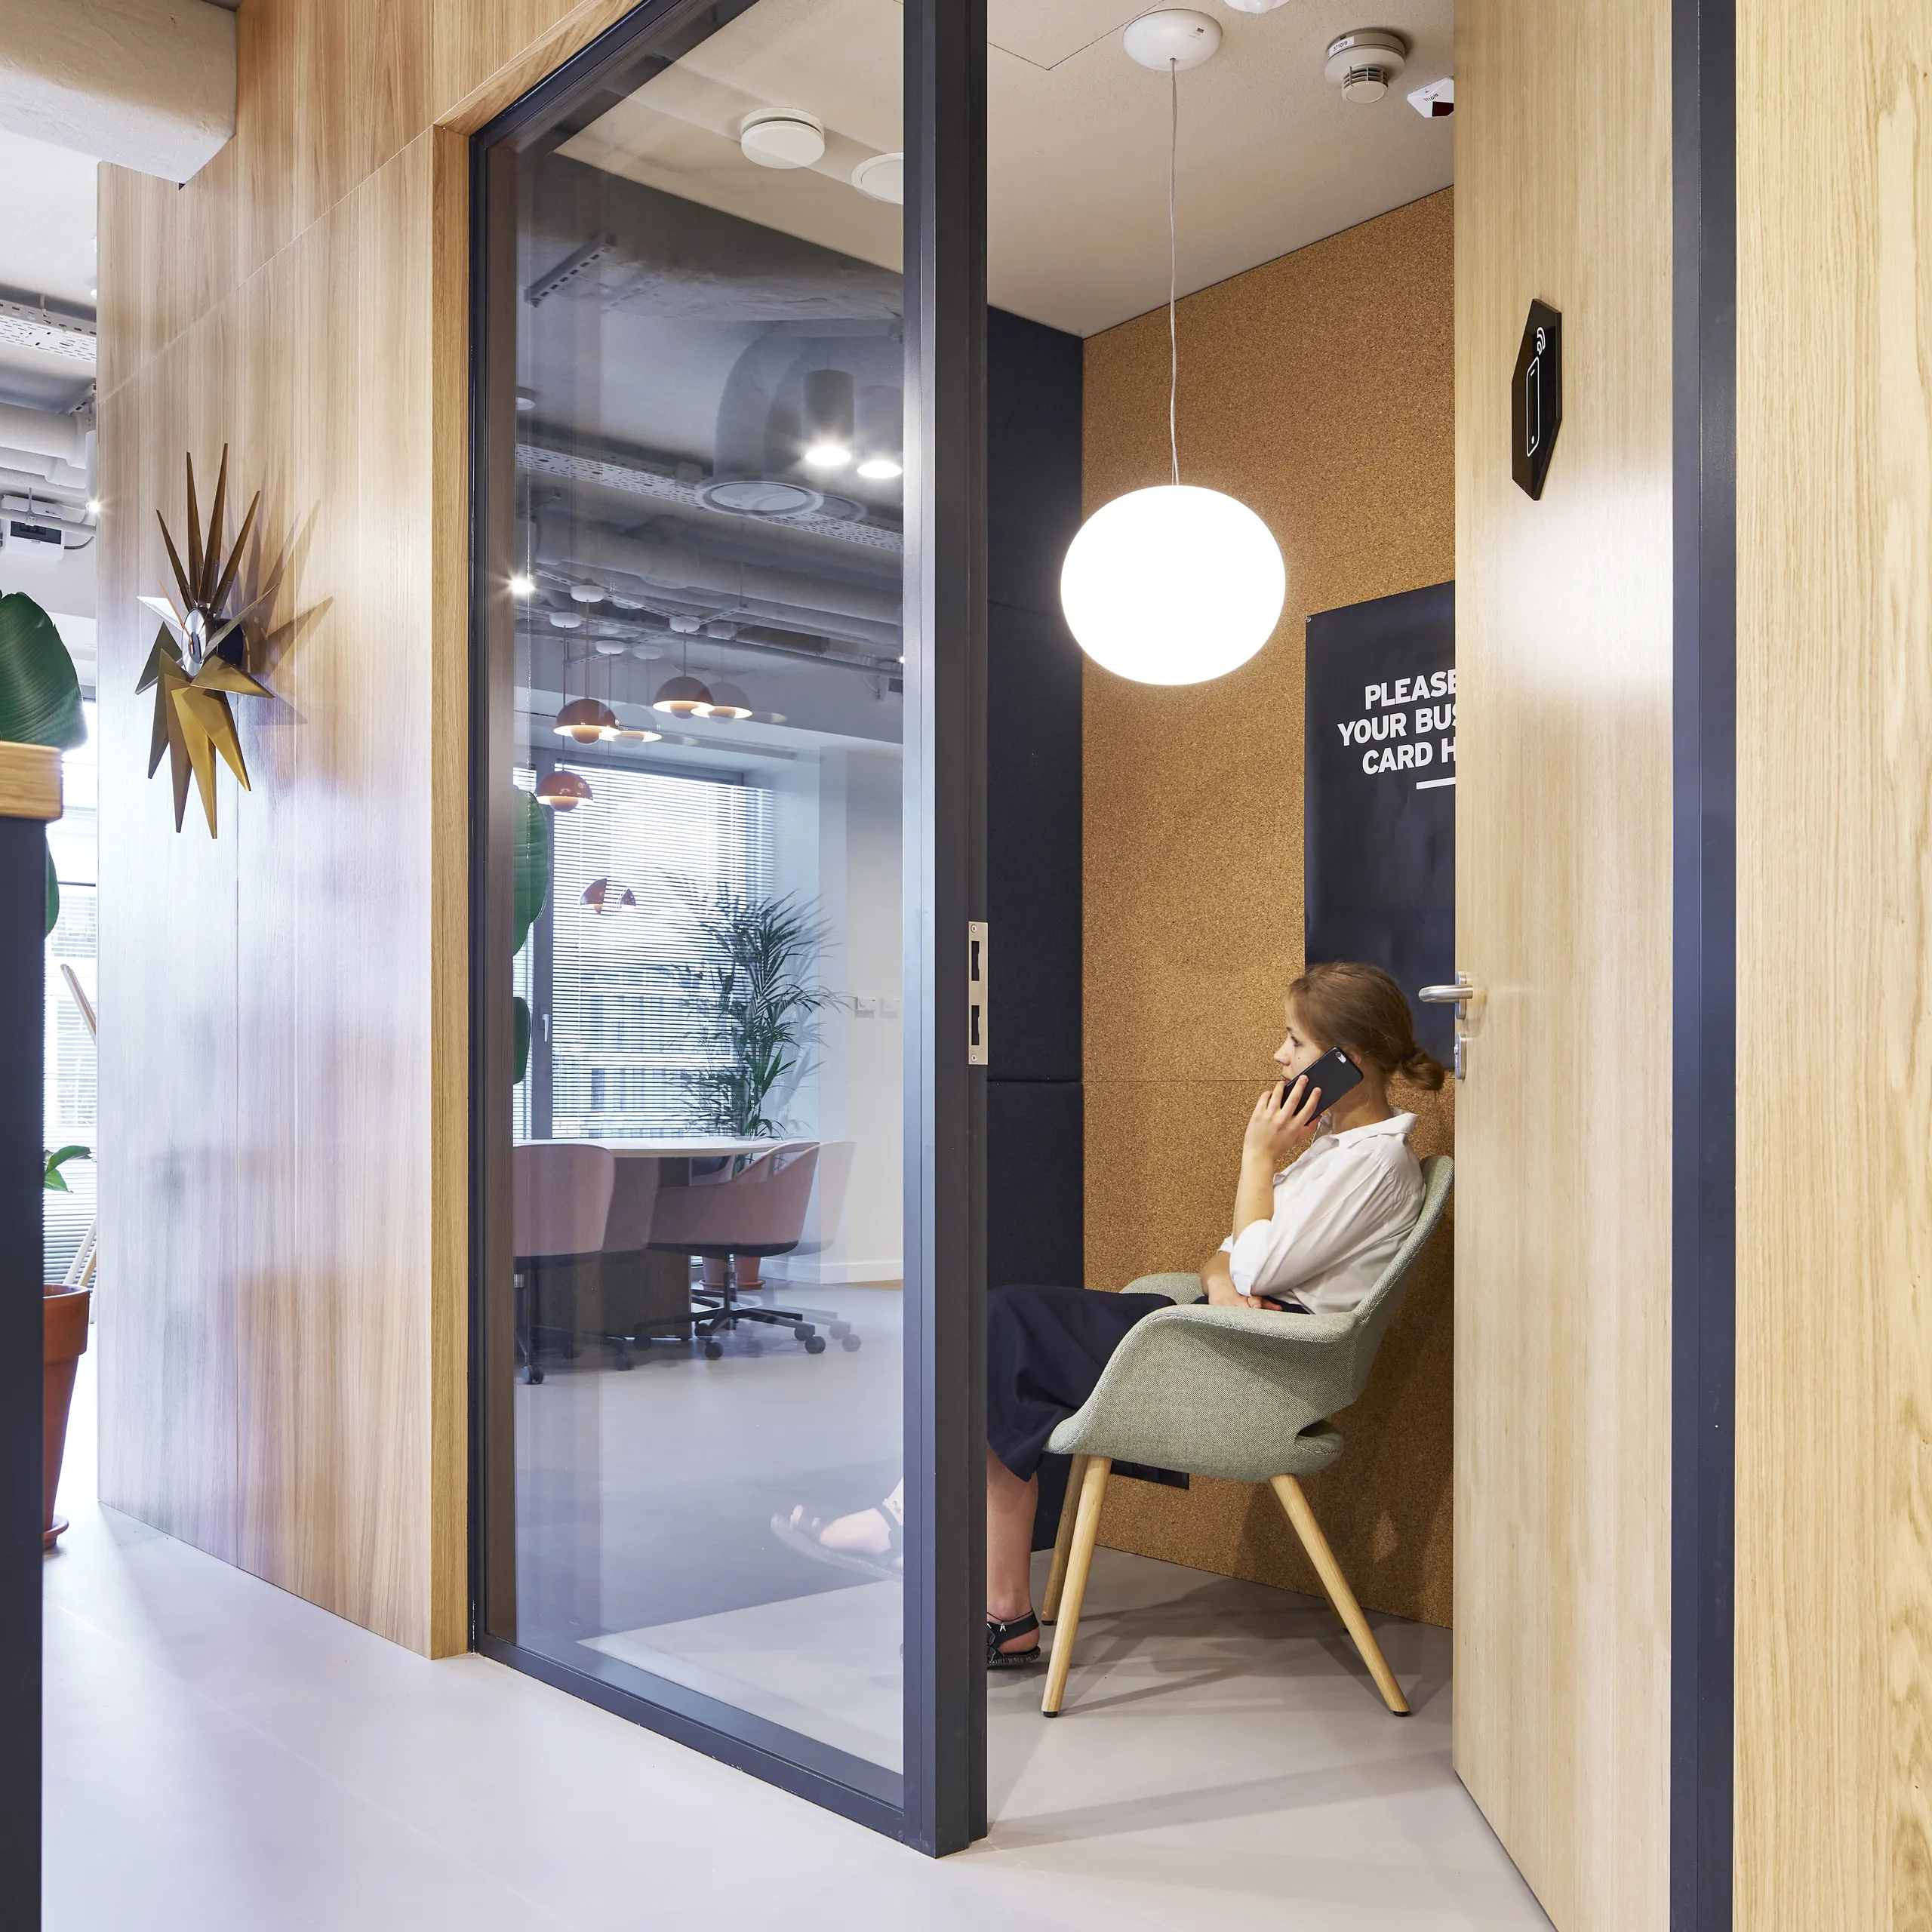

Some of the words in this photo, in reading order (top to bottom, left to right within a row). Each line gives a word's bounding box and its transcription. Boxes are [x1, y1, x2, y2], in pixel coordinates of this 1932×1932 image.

[1333, 40, 1348, 52] 3710/9
[1337, 712, 1407, 746] YOUR
[1415, 703, 1456, 734] BU
[1362, 741, 1433, 775] CARD
